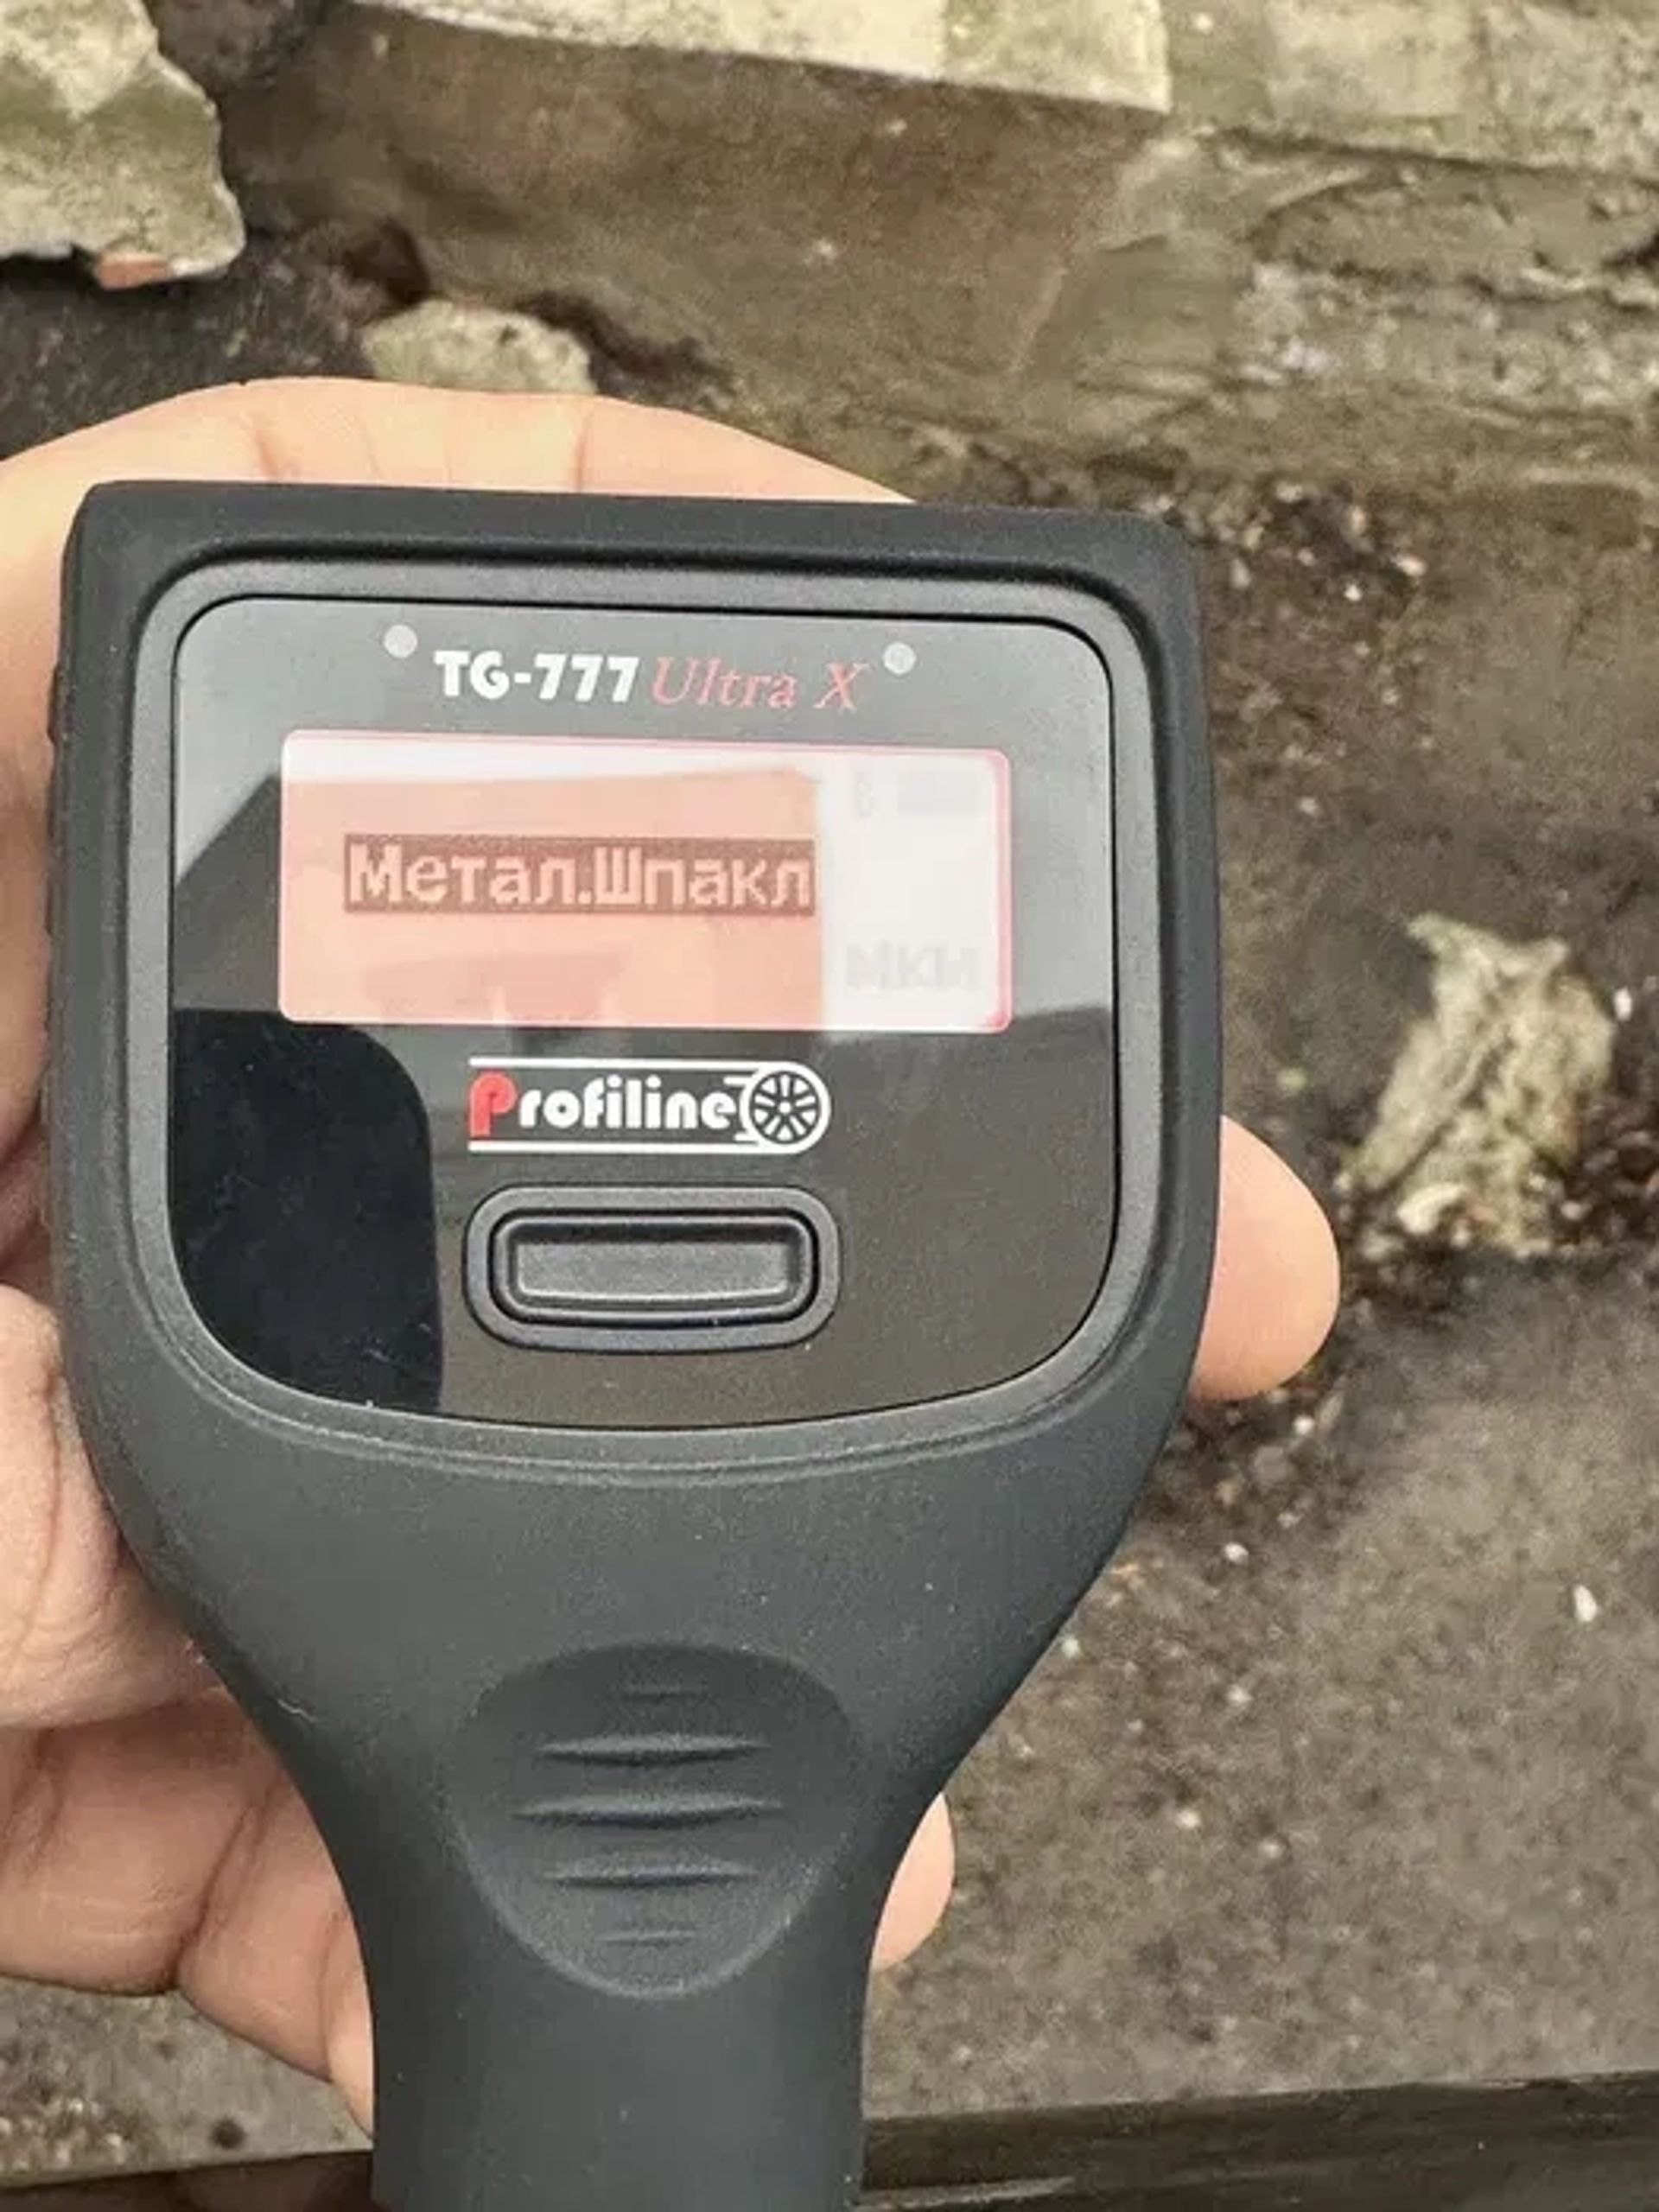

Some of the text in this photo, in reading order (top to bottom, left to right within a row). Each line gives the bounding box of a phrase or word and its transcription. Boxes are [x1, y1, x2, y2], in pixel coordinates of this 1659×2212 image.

[434, 650, 868, 709] TG-777 Ultra X
[348, 843, 812, 907] Метал.Шпакл
[469, 1071, 737, 1138] Profiline
